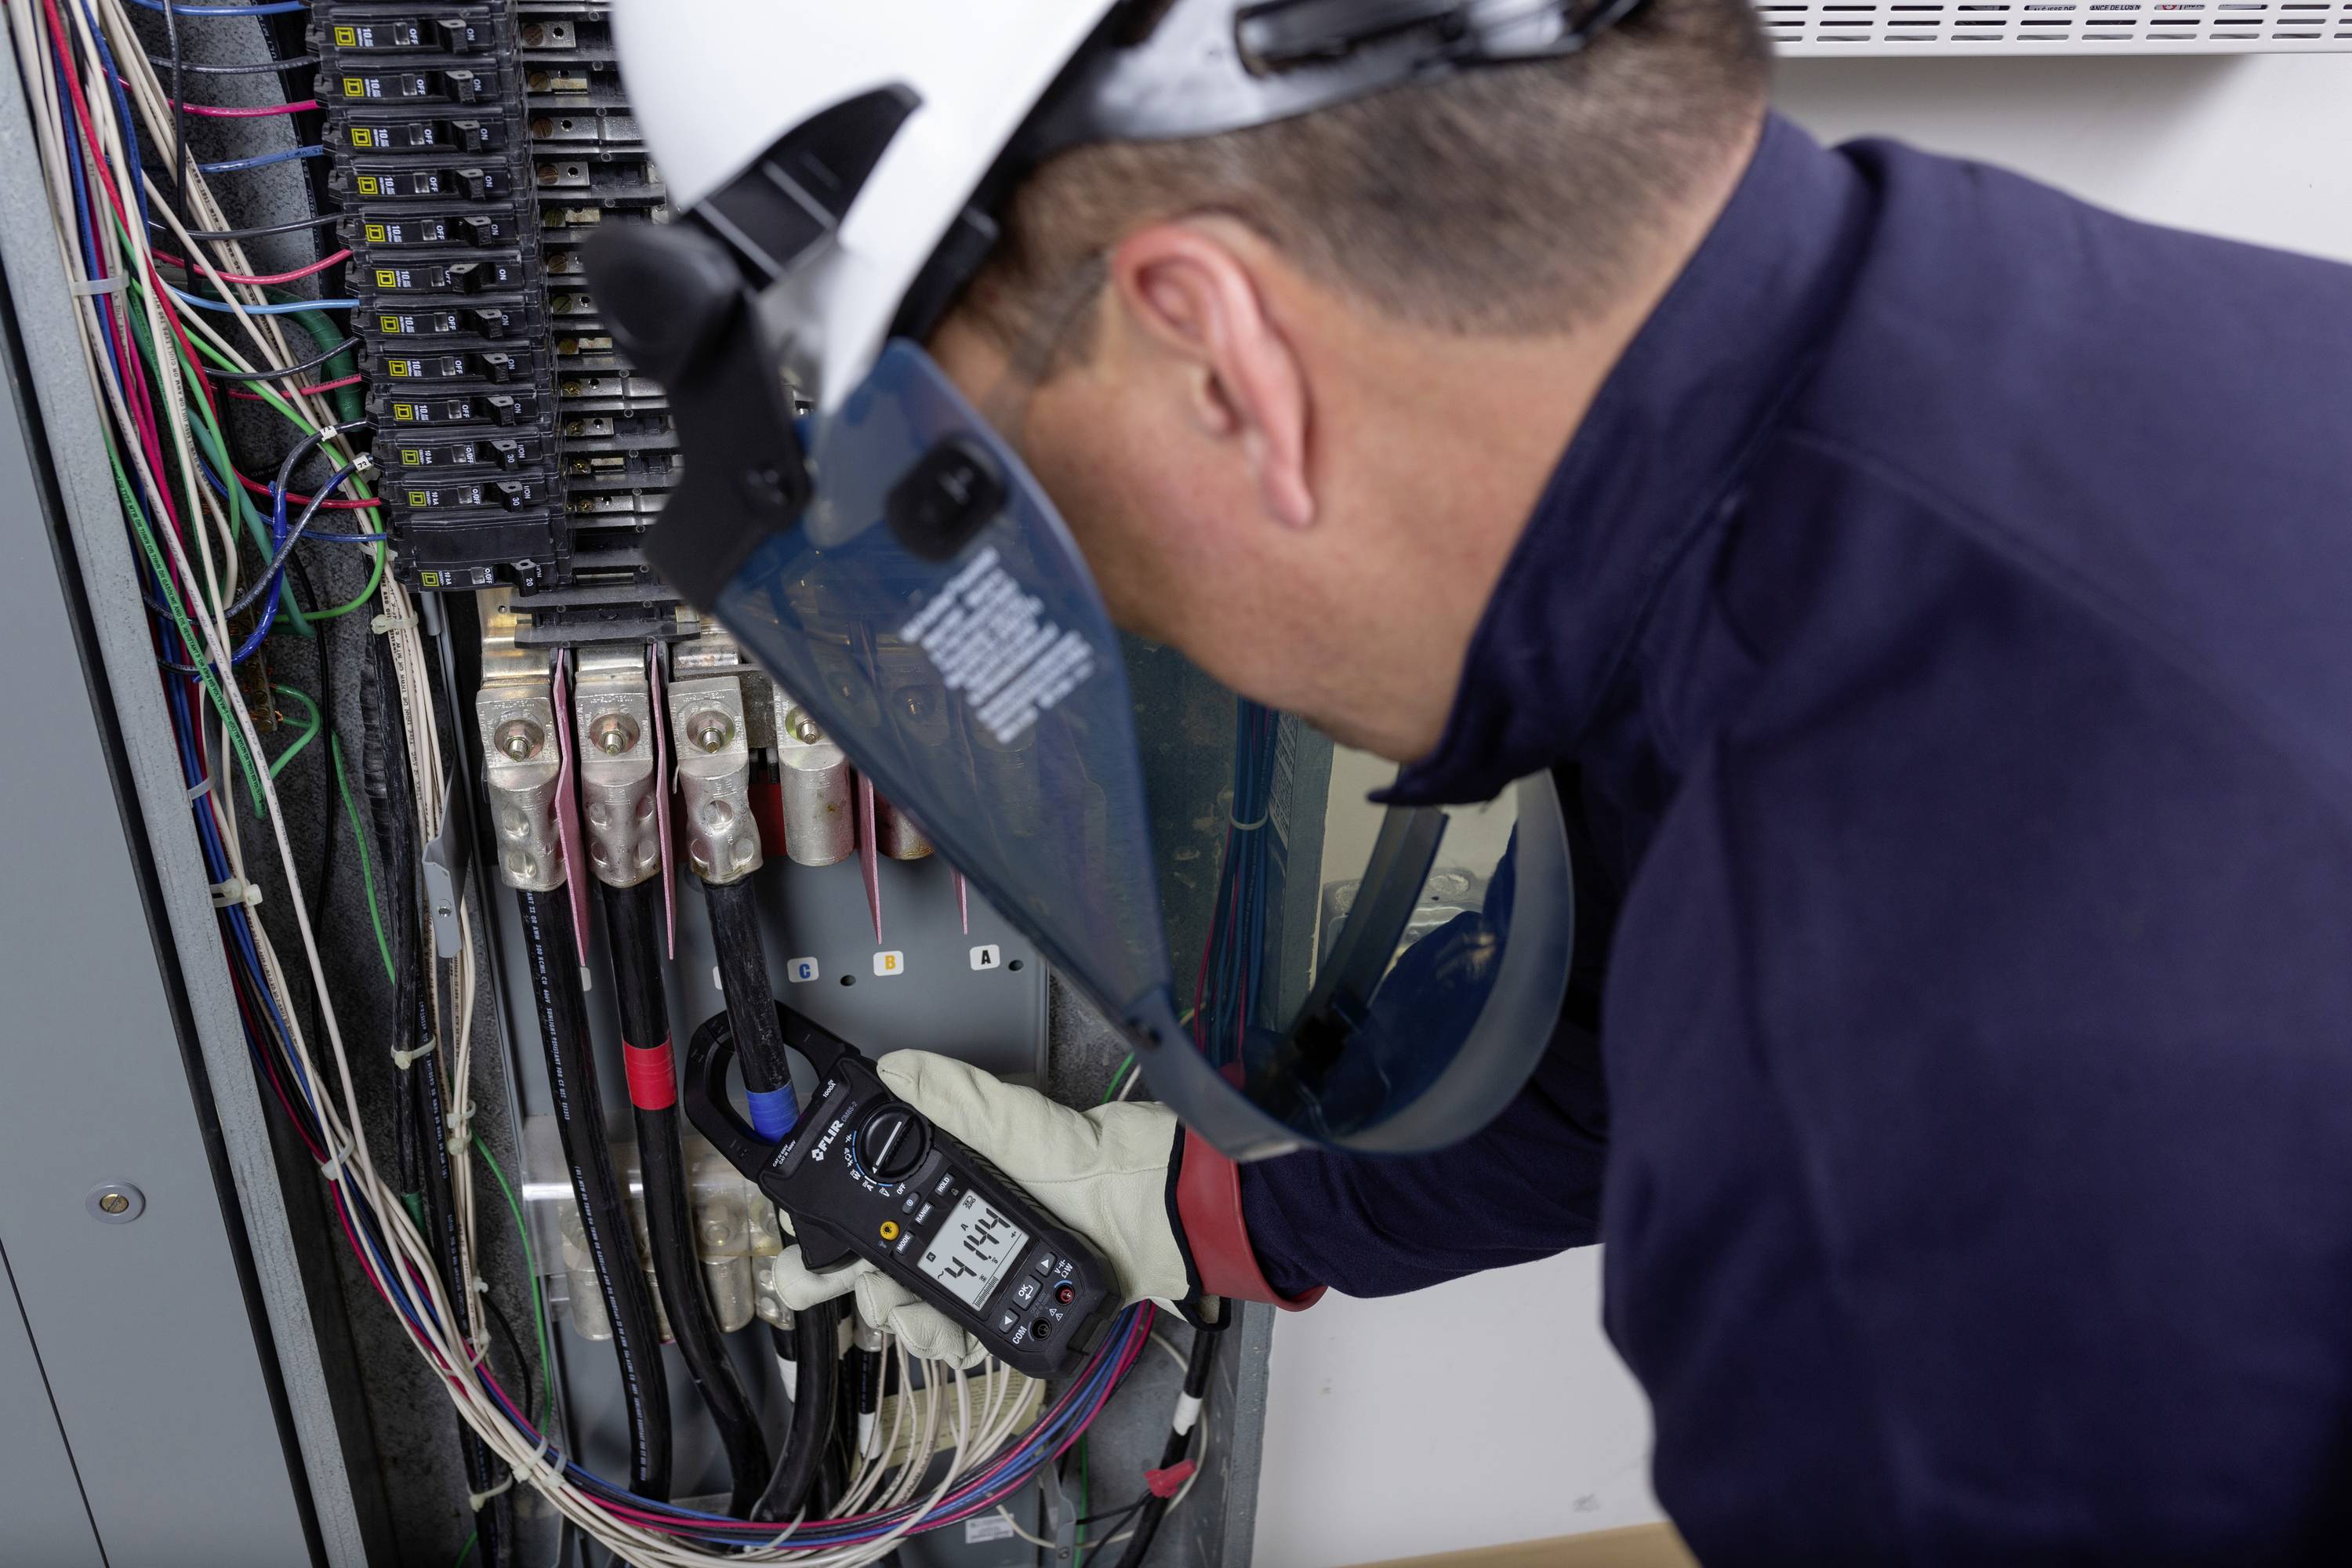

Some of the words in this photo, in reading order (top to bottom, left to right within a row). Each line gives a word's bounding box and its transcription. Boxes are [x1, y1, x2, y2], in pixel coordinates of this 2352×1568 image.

[409, 28, 419, 45] OFF
[466, 28, 475, 41] ON
[416, 78, 426, 96] OFF
[473, 78, 481, 91] ON
[425, 129, 434, 145] OFF
[481, 128, 488, 140] ON
[190, 167, 201, 183] AWG
[485, 176, 493, 187] ON
[437, 225, 445, 240] OFF
[491, 224, 499, 235] ON
[499, 269, 507, 281] ON
[448, 315, 456, 332] OFF
[502, 314, 509, 325] ON
[455, 360, 463, 376] OFF
[507, 358, 515, 369] ON
[172, 368, 179, 377] OR
[174, 379, 183, 395] AWM
[178, 396, 185, 407] OR
[514, 403, 521, 414] ON
[462, 405, 470, 419] OFF
[507, 454, 514, 463] 30
[512, 497, 520, 506] 30
[526, 577, 534, 586] 20
[146, 544, 154, 554] OR
[172, 605, 182, 617] AND
[197, 658, 205, 667] OR
[397, 661, 404, 670] OR
[402, 695, 408, 706] OR
[530, 914, 537, 924] OR
[532, 925, 540, 940] AWM
[885, 955, 896, 971] B
[981, 949, 992, 965] A
[799, 964, 811, 979] C
[540, 975, 547, 985] CU
[545, 1007, 557, 1035] SUNLIGHT
[549, 1036, 563, 1065] RESISTANT
[557, 1079, 564, 1087] CT
[818, 1120, 844, 1152] FLIR
[896, 1182, 906, 1195] OFF
[937, 1177, 950, 1193] HOLD
[916, 1203, 931, 1224] RANGE
[577, 1178, 586, 1192] MTW
[602, 1273, 611, 1286] AND
[960, 1223, 969, 1232] A
[897, 1233, 911, 1252] MODE
[1018, 1283, 1029, 1297] OK
[1012, 1325, 1028, 1345] COM
